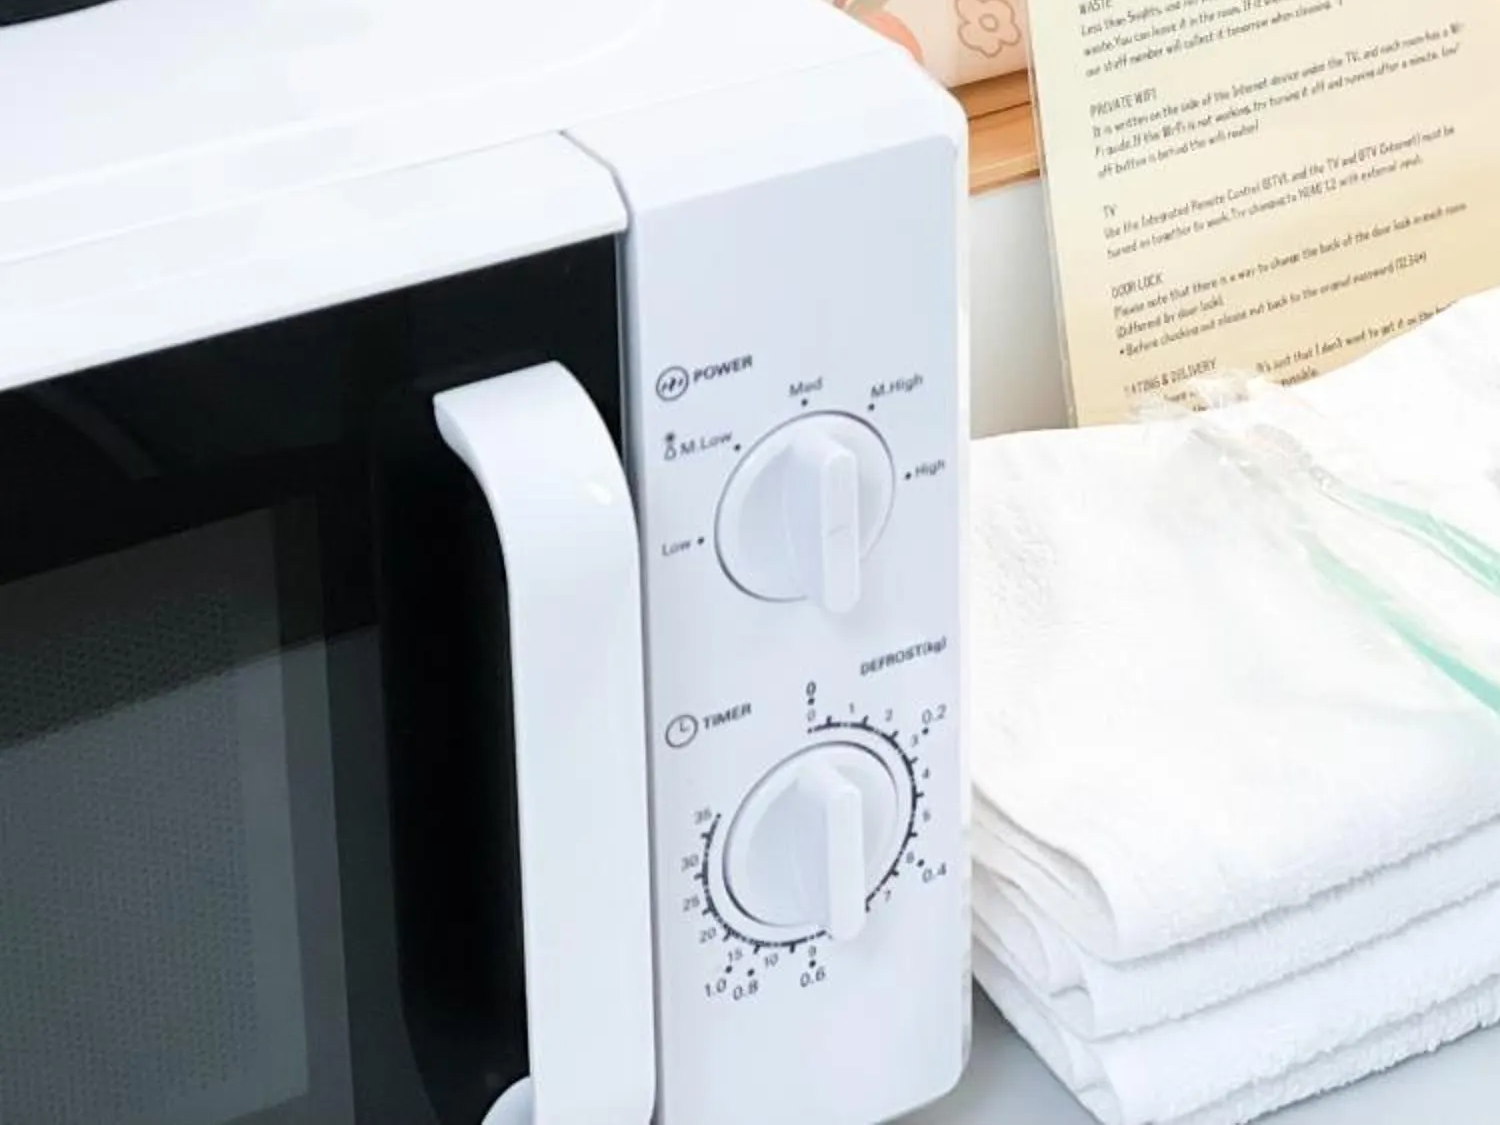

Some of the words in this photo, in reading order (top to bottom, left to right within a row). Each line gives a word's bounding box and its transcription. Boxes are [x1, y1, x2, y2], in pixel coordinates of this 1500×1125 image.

[693, 354, 753, 382] POWER
[788, 377, 823, 396] Med
[869, 373, 924, 398] M.High
[679, 431, 733, 456] M.Low
[914, 459, 946, 478] High
[661, 537, 692, 557] Low
[860, 636, 947, 676] DEFROST(kg)
[805, 681, 817, 697] 0
[701, 702, 752, 730] TIMER
[921, 703, 947, 725] 0.2
[681, 854, 700, 873] 30
[921, 862, 947, 884] 0.4
[682, 894, 701, 913] 25
[700, 927, 717, 944] 20
[763, 953, 779, 970] 10
[799, 965, 826, 989] 0.6
[704, 978, 727, 999] 1.0
[732, 980, 759, 1003] 0.8
